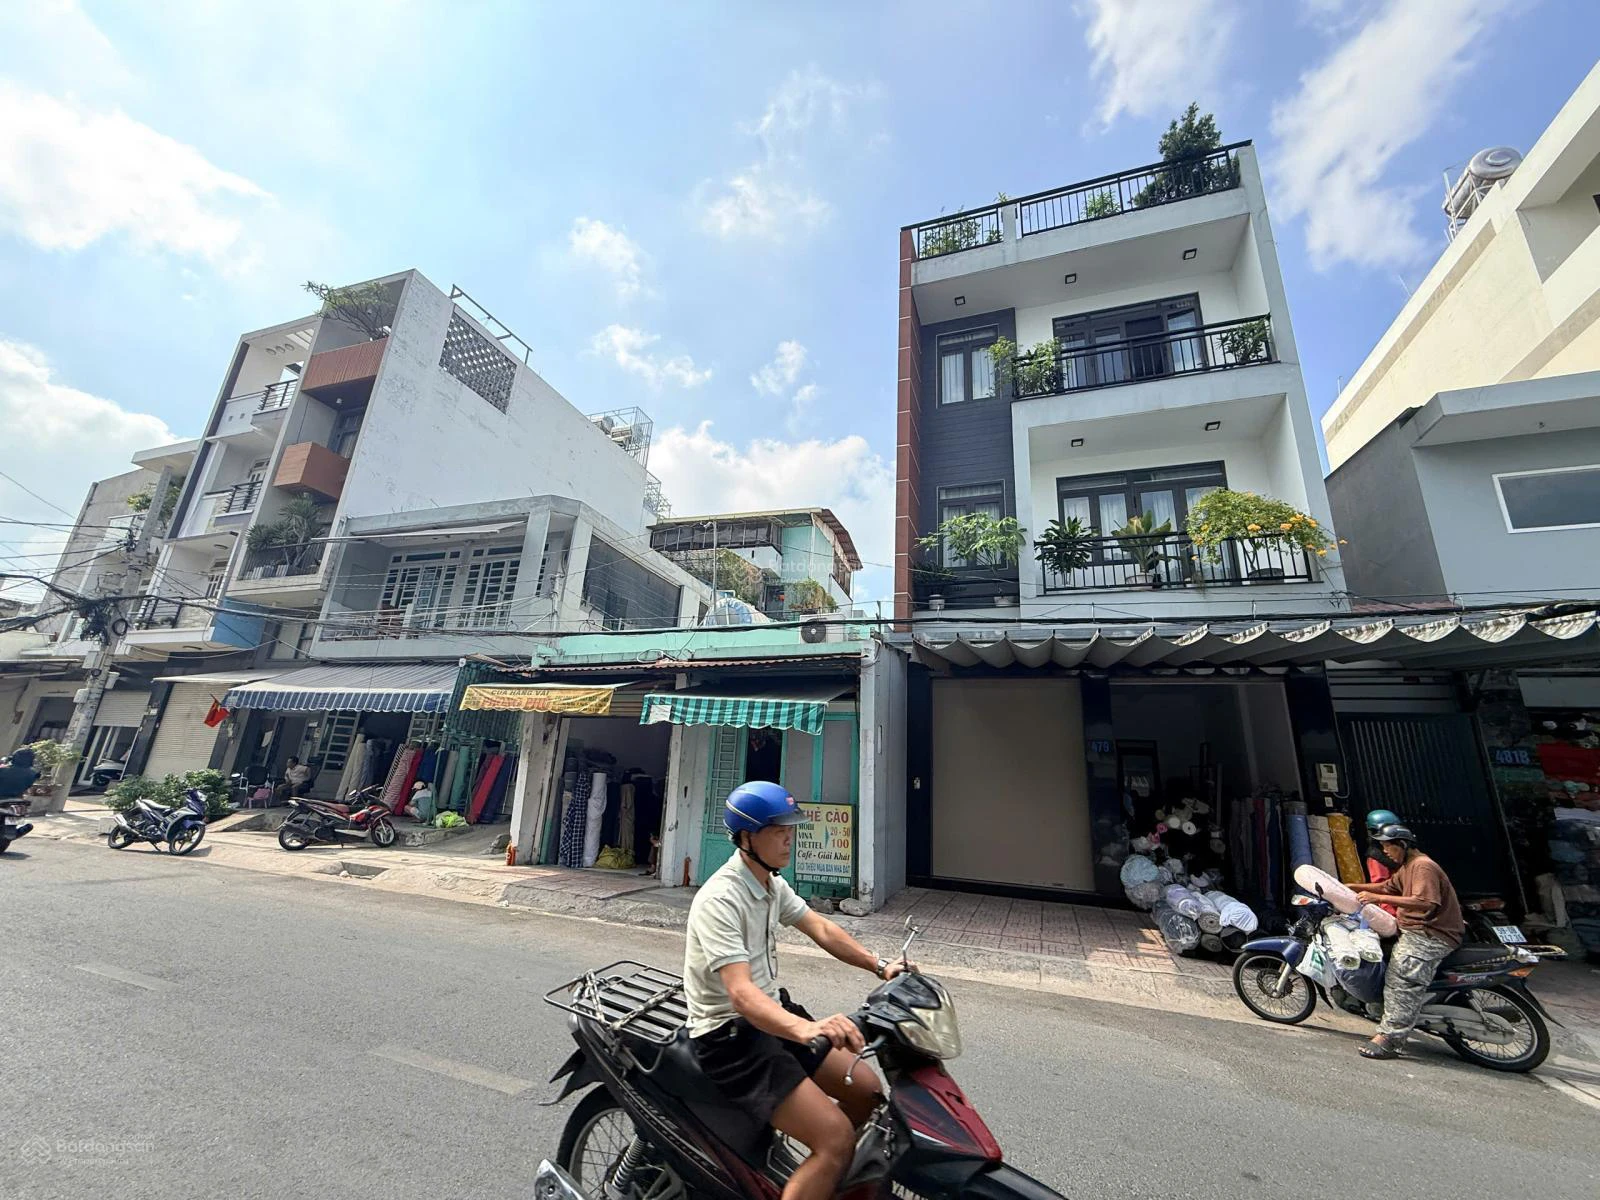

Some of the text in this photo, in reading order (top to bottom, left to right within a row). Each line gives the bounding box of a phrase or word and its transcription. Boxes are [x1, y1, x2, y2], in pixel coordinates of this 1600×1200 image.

[825, 808, 849, 823] CÀO
[798, 832, 813, 840] VINA
[797, 841, 823, 850] VIETTEL
[832, 838, 849, 849] 100
